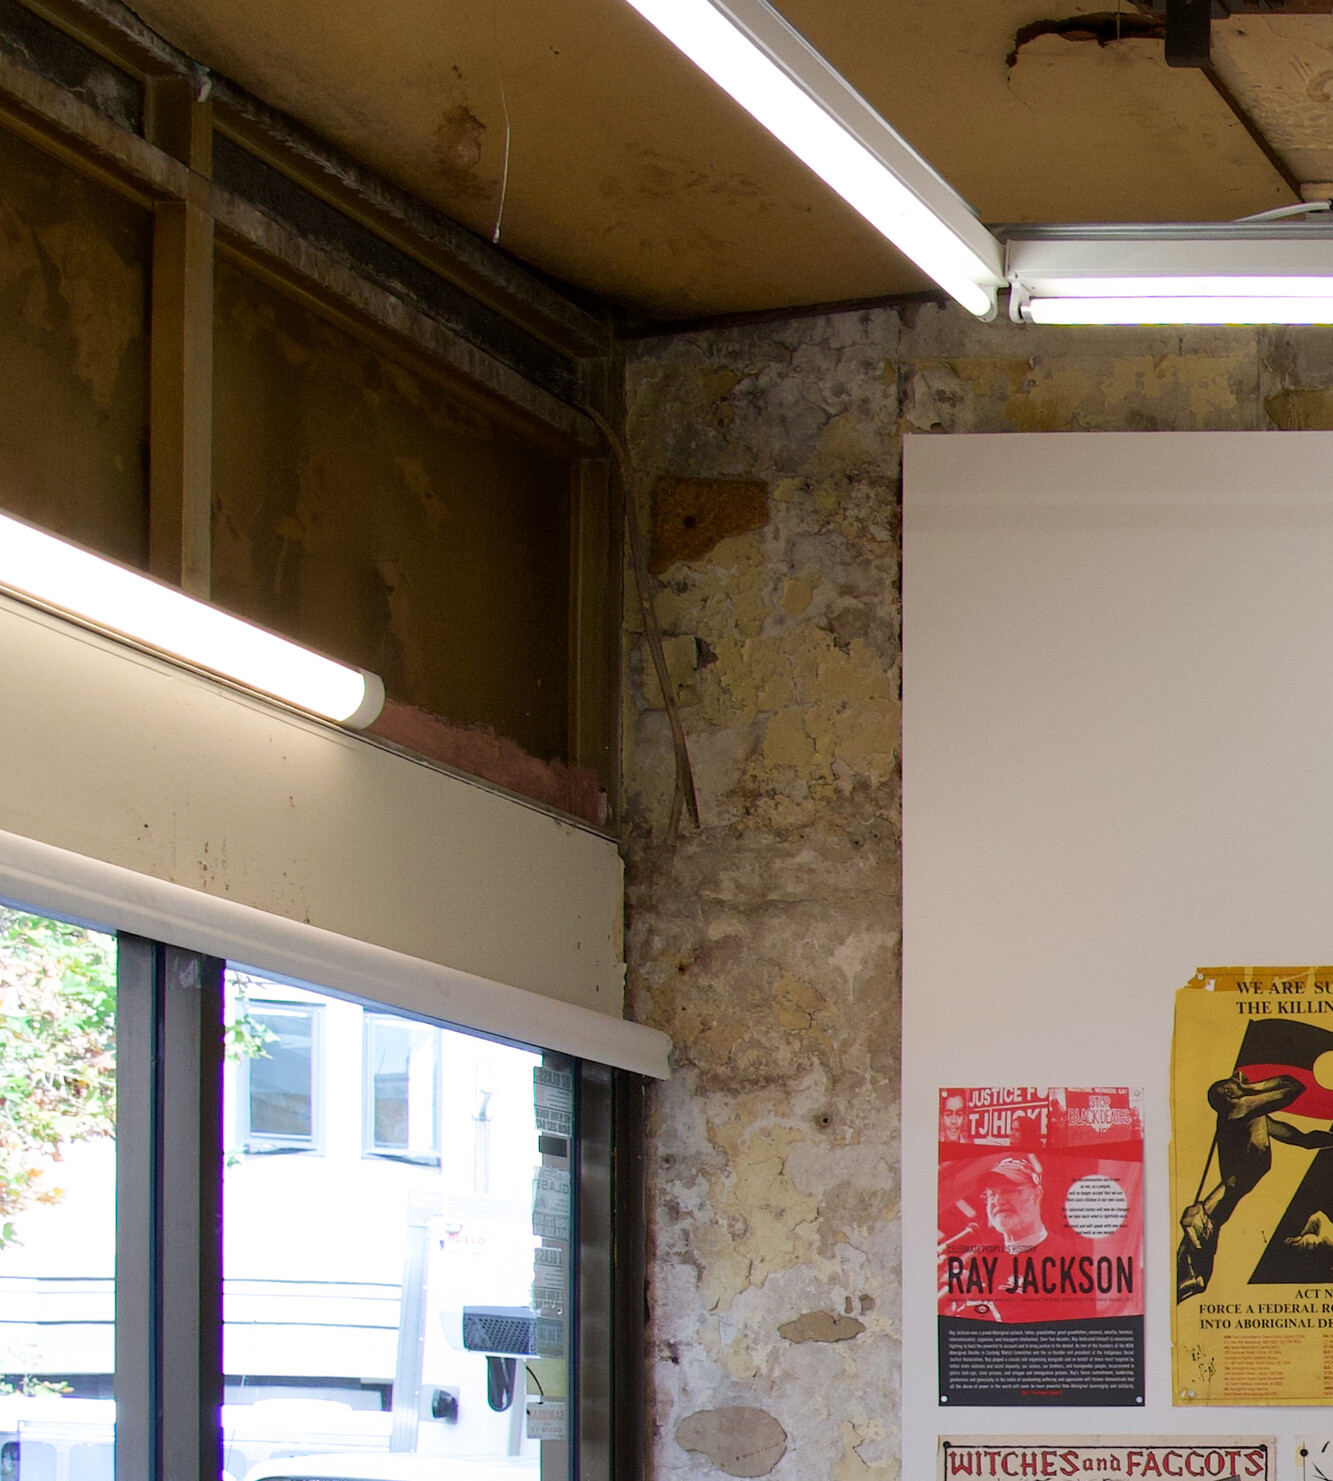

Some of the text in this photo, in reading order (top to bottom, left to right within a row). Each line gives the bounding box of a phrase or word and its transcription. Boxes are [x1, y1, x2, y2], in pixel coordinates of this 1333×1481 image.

[1236, 981, 1263, 995] WE
[1269, 981, 1305, 994] ARE
[1236, 1001, 1271, 1015] THE
[969, 1088, 1022, 1108] JUSTICE
[948, 1256, 1134, 1294] RAY JACKSON
[1199, 1304, 1241, 1314] FORCE
[1245, 1304, 1254, 1314] A
[1258, 1303, 1318, 1314] FEDERAL
[948, 1450, 1265, 1477] WITCHES and FAGGOTS
